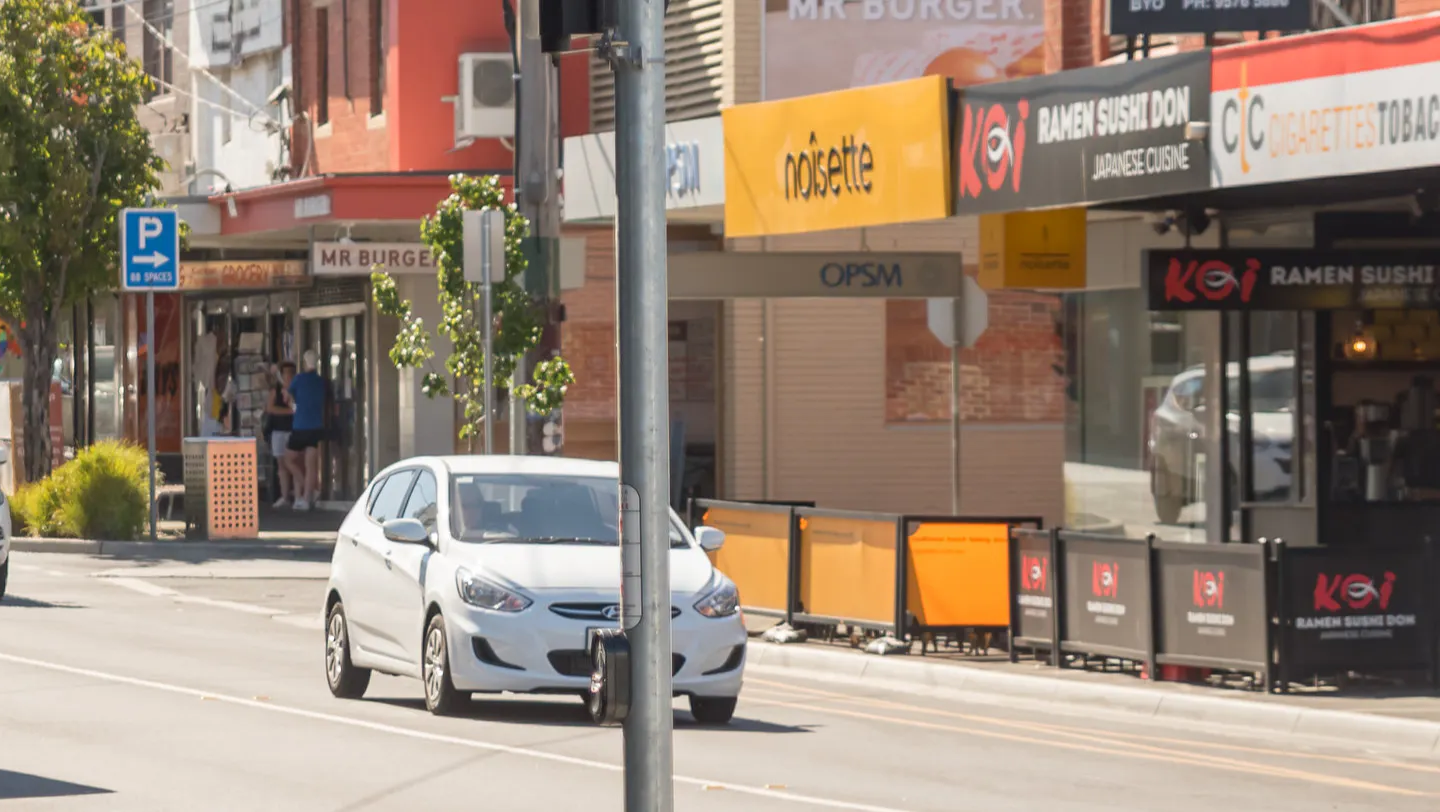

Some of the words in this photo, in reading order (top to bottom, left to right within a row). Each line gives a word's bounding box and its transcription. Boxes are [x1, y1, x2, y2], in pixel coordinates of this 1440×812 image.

[788, 0, 847, 20] MR
[1037, 100, 1096, 145] RAMEN
[1096, 91, 1149, 137] SUSHI
[1150, 85, 1191, 130] DON
[1091, 150, 1145, 181] JAPANESE
[1146, 143, 1191, 172] CUISINE
[138, 216, 163, 250] P
[321, 249, 352, 267] MR
[359, 249, 438, 268] BURGE
[820, 262, 903, 288] OPSM
[1270, 265, 1355, 285] RAMEN
[1360, 264, 1435, 284] SUSHI
[1295, 616, 1342, 629] RAMEN
[1386, 614, 1416, 626] DON
